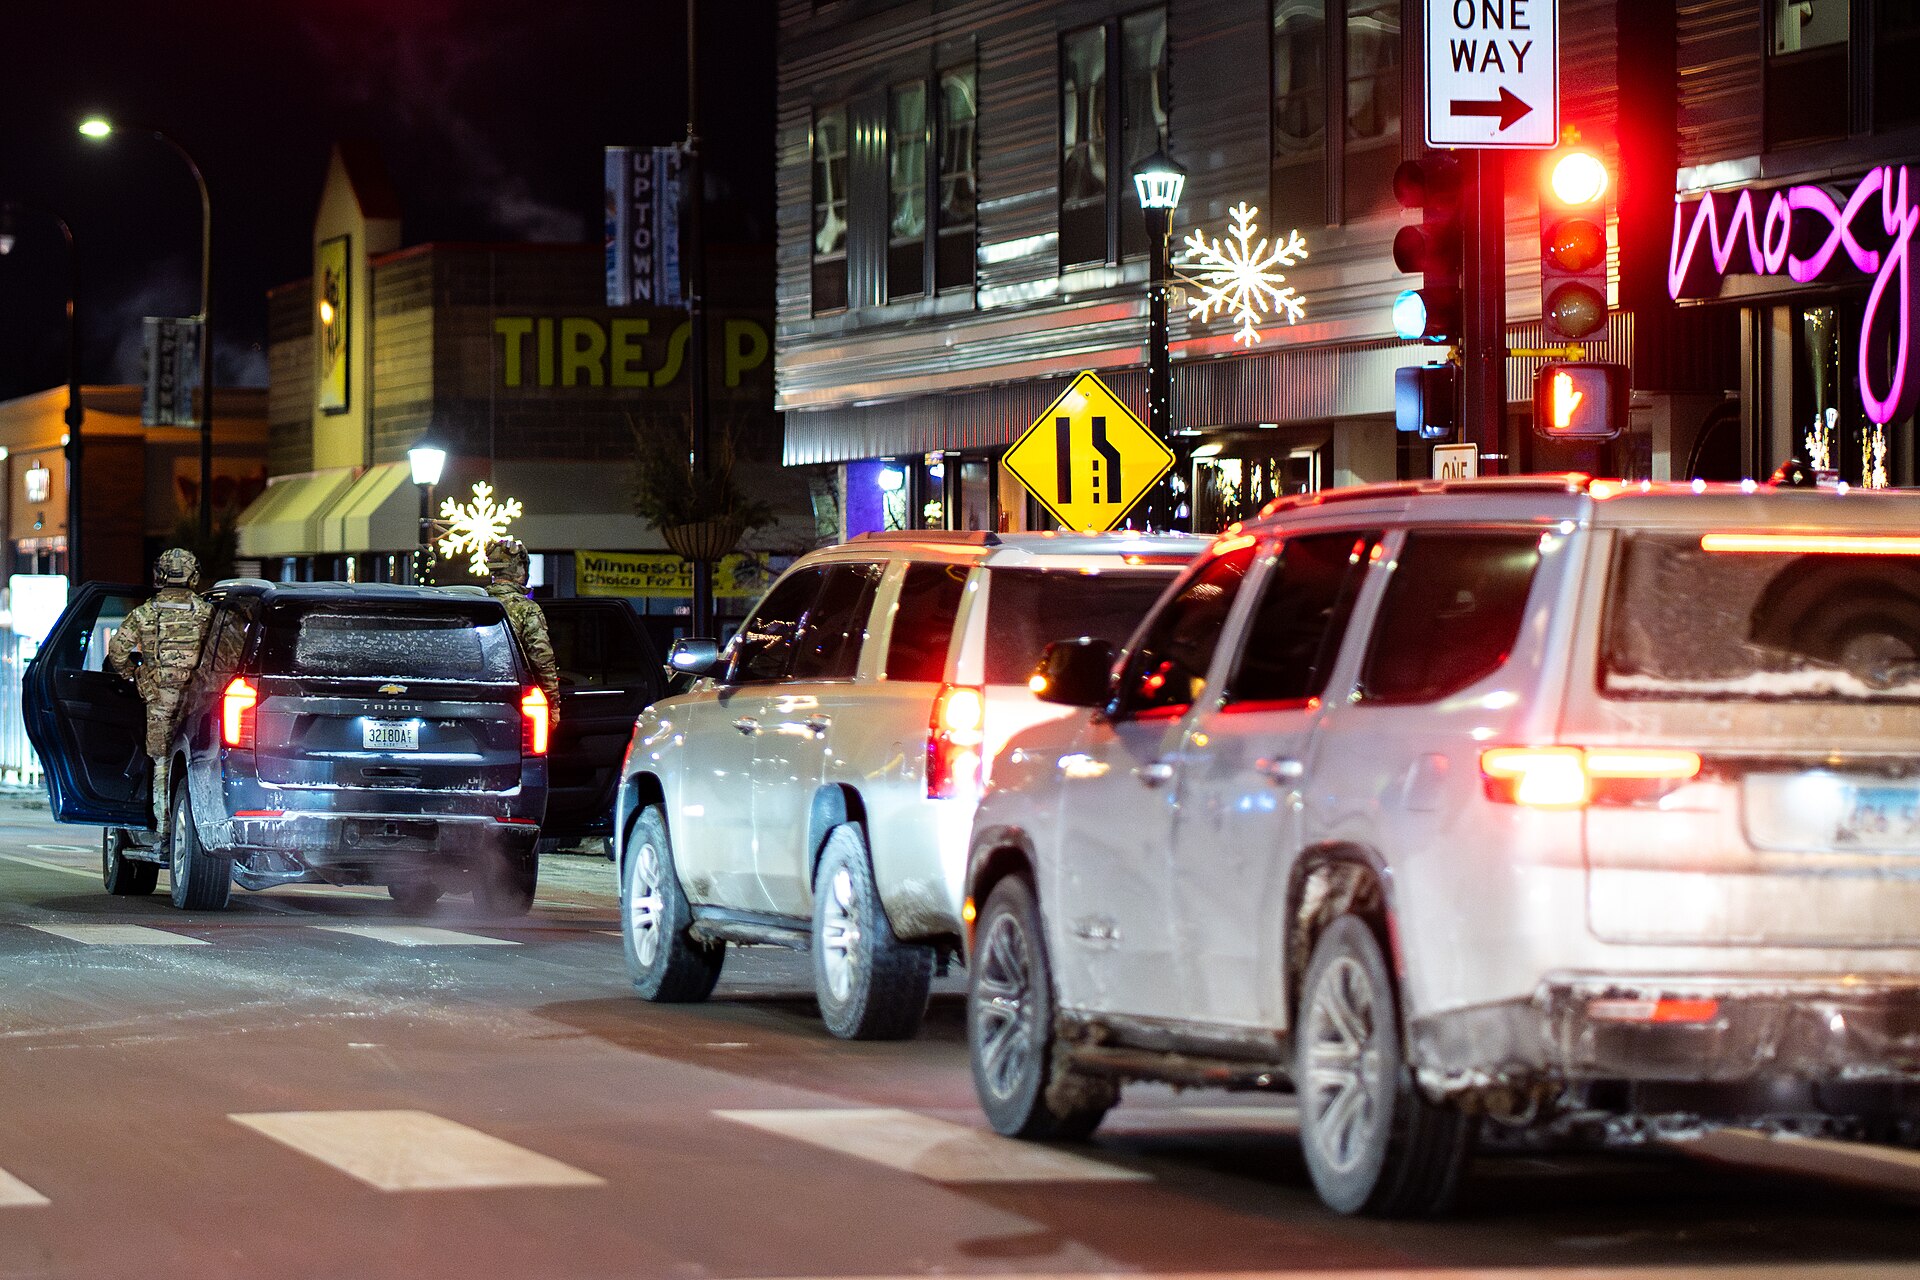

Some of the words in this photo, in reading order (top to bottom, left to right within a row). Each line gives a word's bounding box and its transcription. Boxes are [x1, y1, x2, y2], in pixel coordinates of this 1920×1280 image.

[1453, 0, 1530, 30] ONE
[1450, 39, 1533, 73] WAY
[632, 152, 651, 301] UPTOWN
[495, 317, 692, 388] TIRES
[1442, 461, 1468, 479] ONE
[646, 576, 675, 587] For
[361, 703, 423, 712] TAHOE
